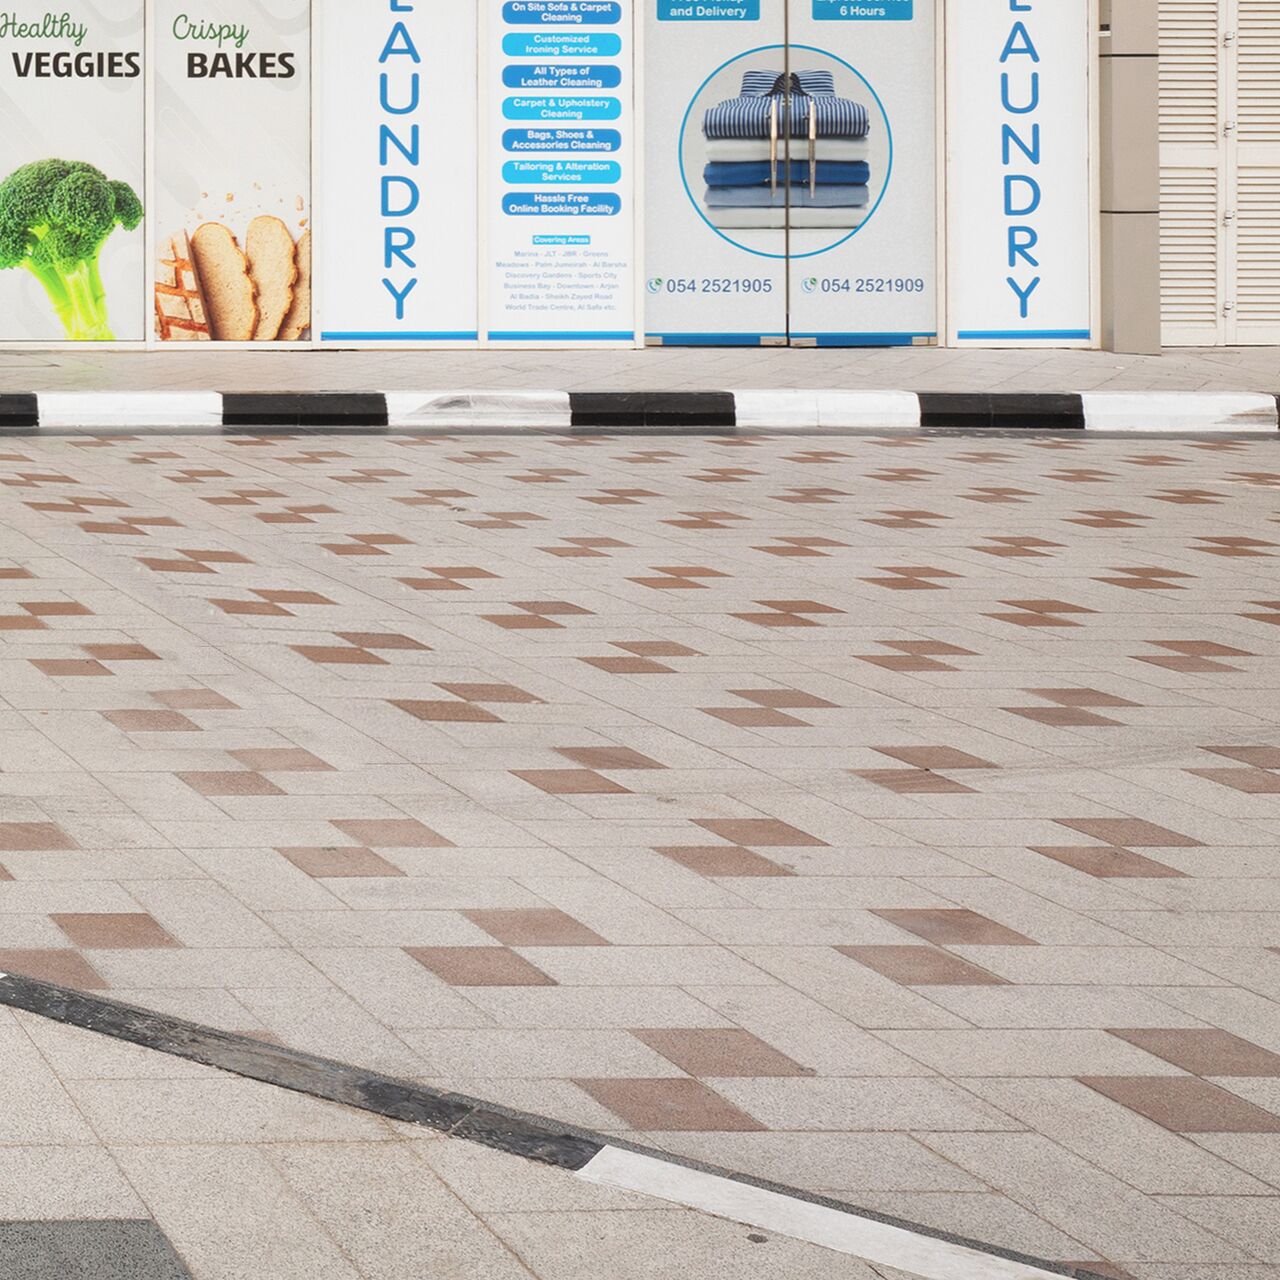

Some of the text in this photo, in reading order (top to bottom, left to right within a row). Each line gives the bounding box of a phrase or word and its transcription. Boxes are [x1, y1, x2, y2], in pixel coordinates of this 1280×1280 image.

[512, 3, 611, 13] On Site Sofa & Carpet
[670, 6, 747, 18] and Delivery
[840, 6, 886, 16] 6 Hours
[541, 13, 582, 23] Cleaning
[0, 12, 88, 47] Healthy
[172, 13, 250, 48] Crispy
[534, 35, 590, 43] Customized
[526, 45, 598, 55] Ironing Service
[12, 52, 141, 78] VEGGIES
[187, 52, 296, 78] BAKES
[534, 67, 590, 77] All Types of
[521, 78, 602, 88] Leather Cleaning
[513, 99, 610, 108] Carpet & Upholstery
[541, 110, 583, 119] Cleaning
[527, 131, 594, 140] Bags, Shoes &
[512, 141, 612, 151] Accessories Cleaning
[513, 162, 553, 172] Tailoring
[565, 162, 610, 170] Alteration
[542, 173, 582, 181] Services
[534, 194, 589, 203] Hassle Free
[509, 205, 614, 214] Online Booking Facility
[534, 236, 589, 245] Covering Areas
[666, 279, 772, 293] 054 2521905
[821, 278, 924, 292] 054 2521909
